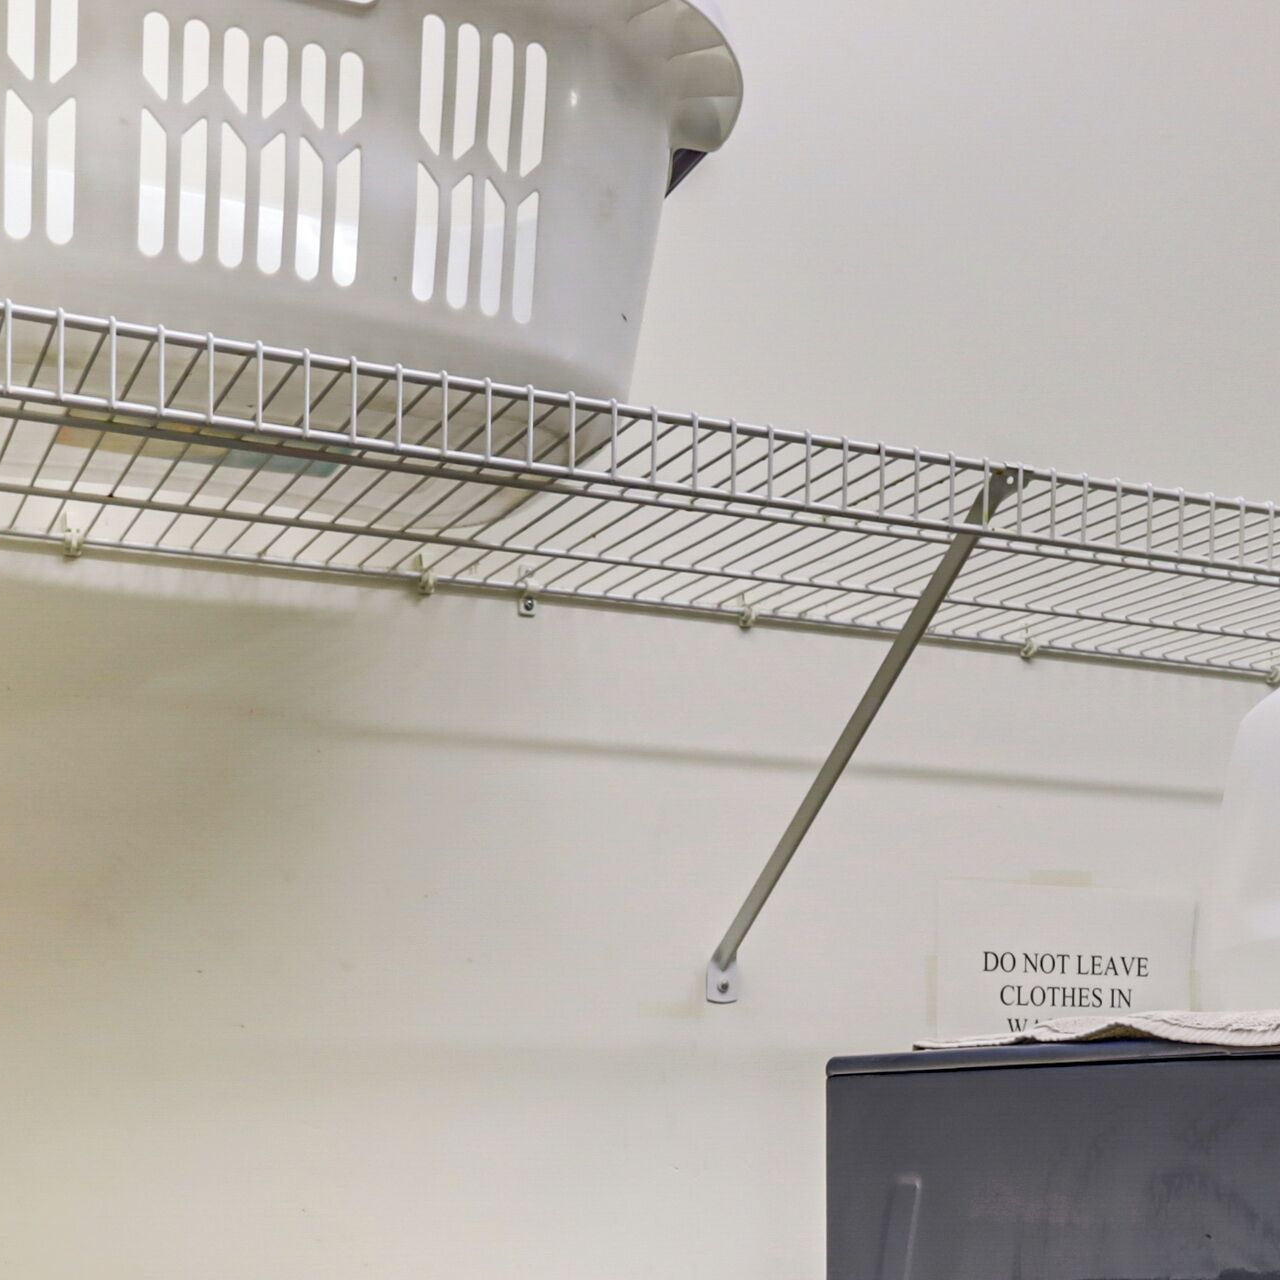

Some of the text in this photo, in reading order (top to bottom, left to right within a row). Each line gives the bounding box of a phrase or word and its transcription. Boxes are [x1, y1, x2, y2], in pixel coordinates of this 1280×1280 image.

[983, 951, 1149, 977] DO NOT LEAVE
[1000, 985, 1132, 1008] CLOTHES IN
